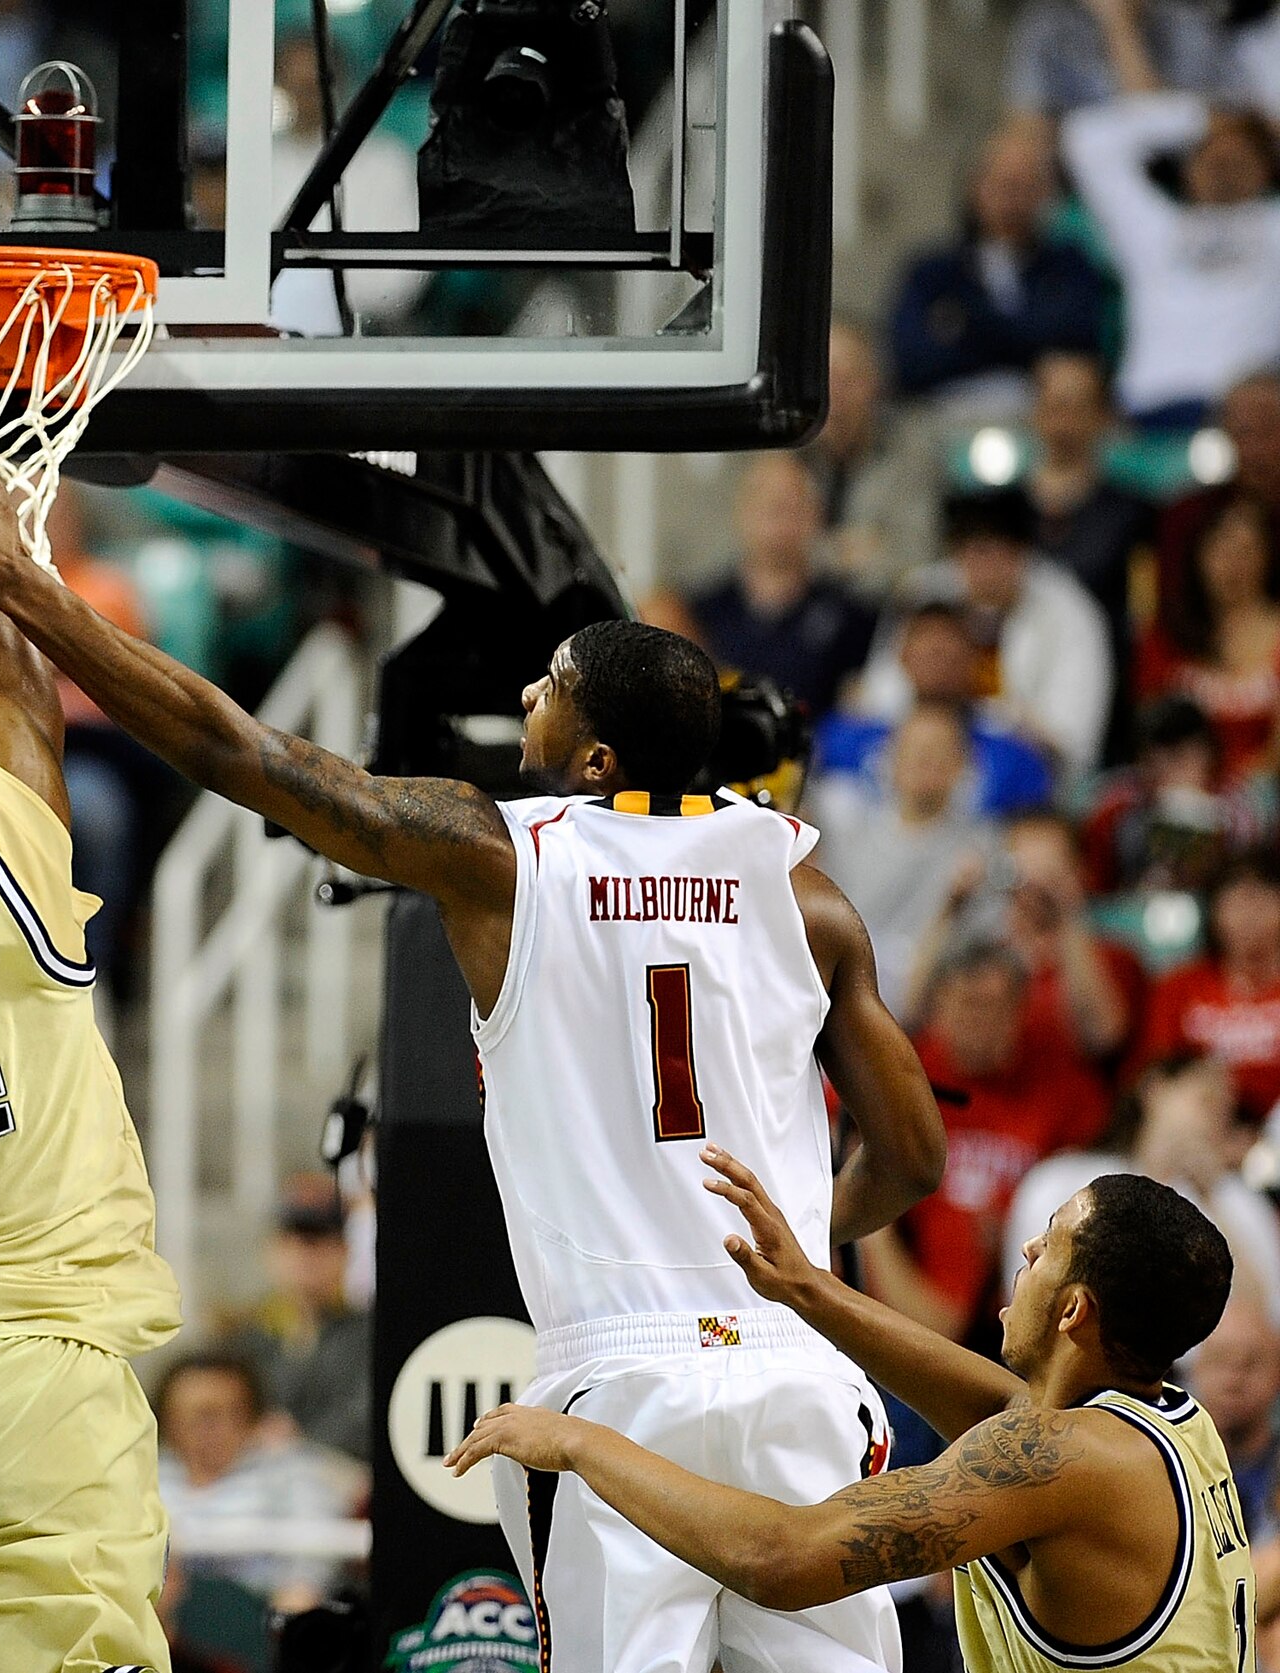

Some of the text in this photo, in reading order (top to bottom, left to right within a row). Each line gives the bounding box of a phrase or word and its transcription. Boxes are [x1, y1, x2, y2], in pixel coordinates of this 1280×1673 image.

[588, 876, 740, 924] MILBOURNE
[646, 962, 707, 1143] 1
[429, 1600, 537, 1643] ACC
